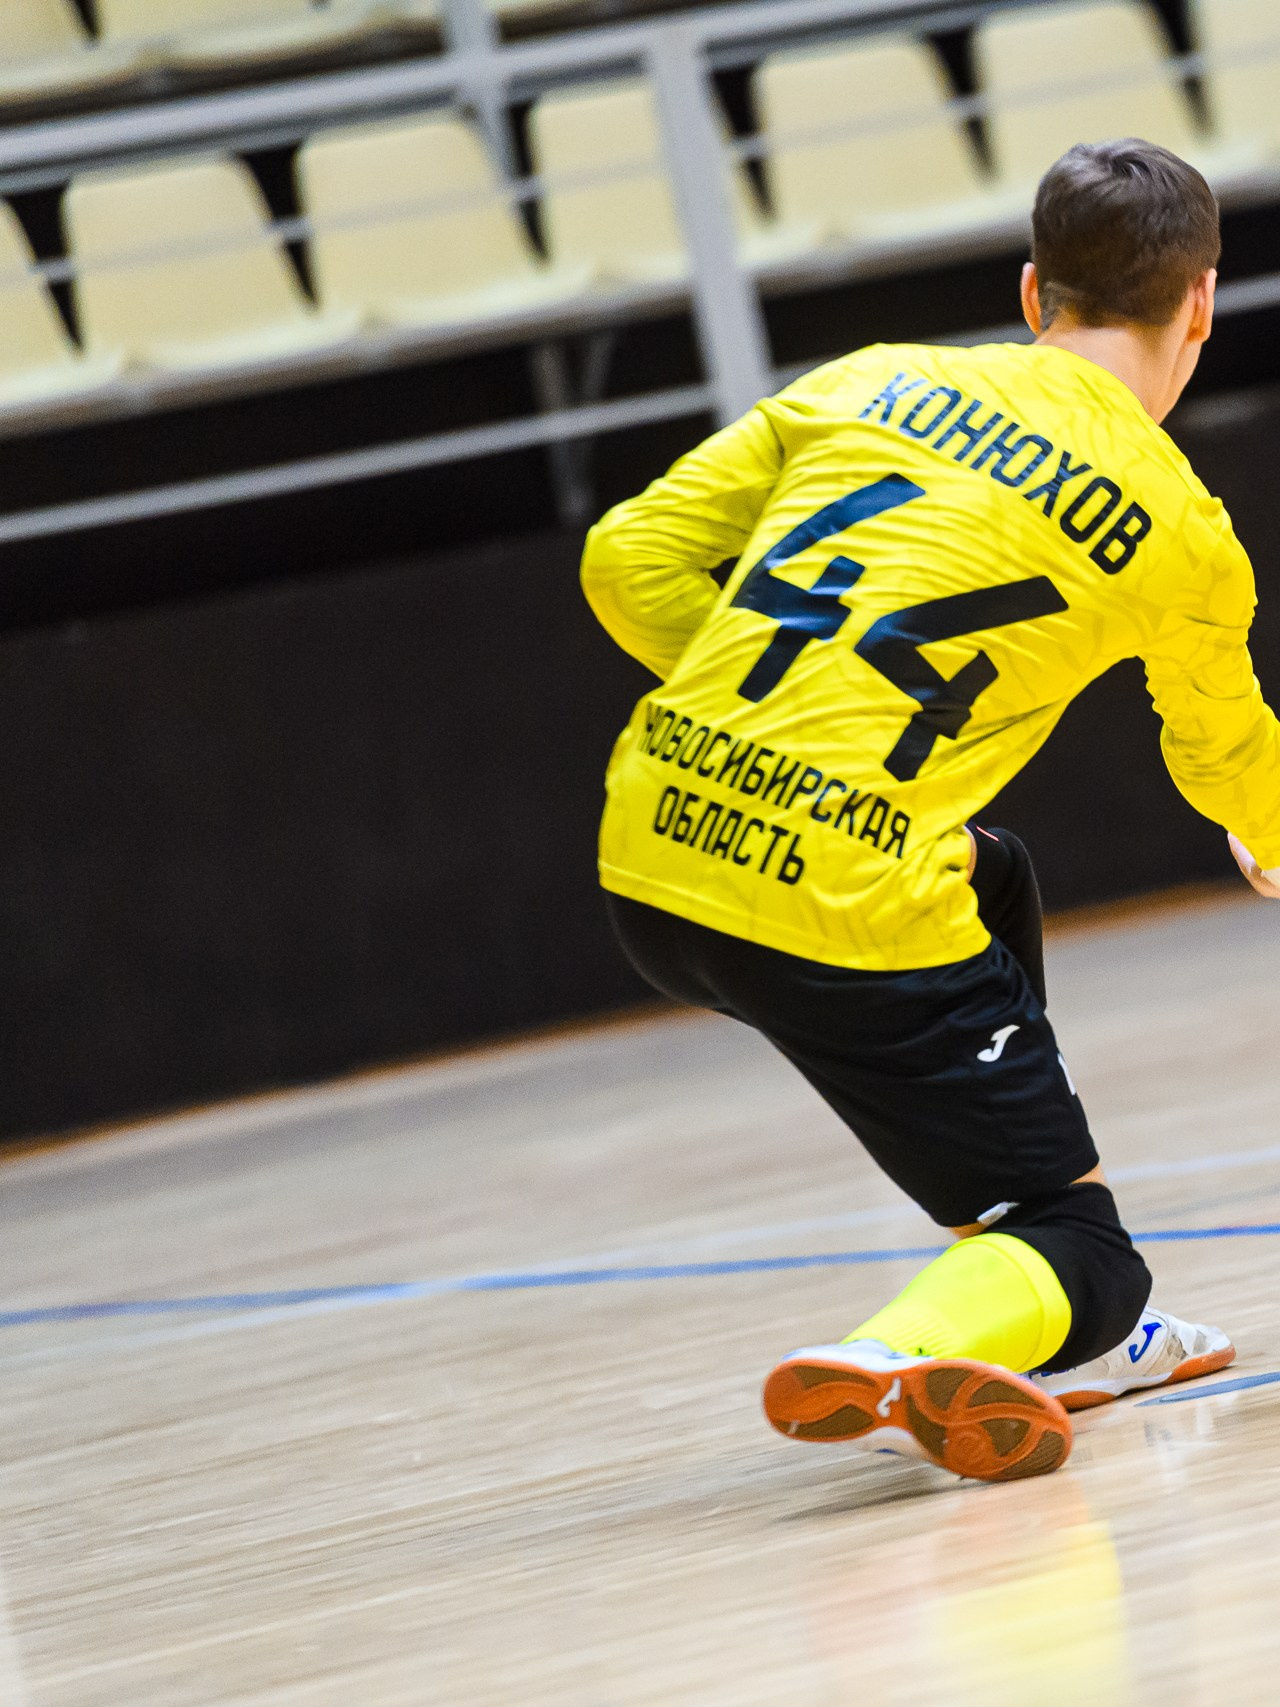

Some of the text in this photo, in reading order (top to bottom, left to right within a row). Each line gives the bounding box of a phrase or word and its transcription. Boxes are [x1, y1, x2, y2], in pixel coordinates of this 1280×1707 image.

[859, 372, 1153, 575] КОНЮХОВ
[729, 472, 1070, 782] 44
[653, 785, 806, 886] ОБЛАСТЬ
